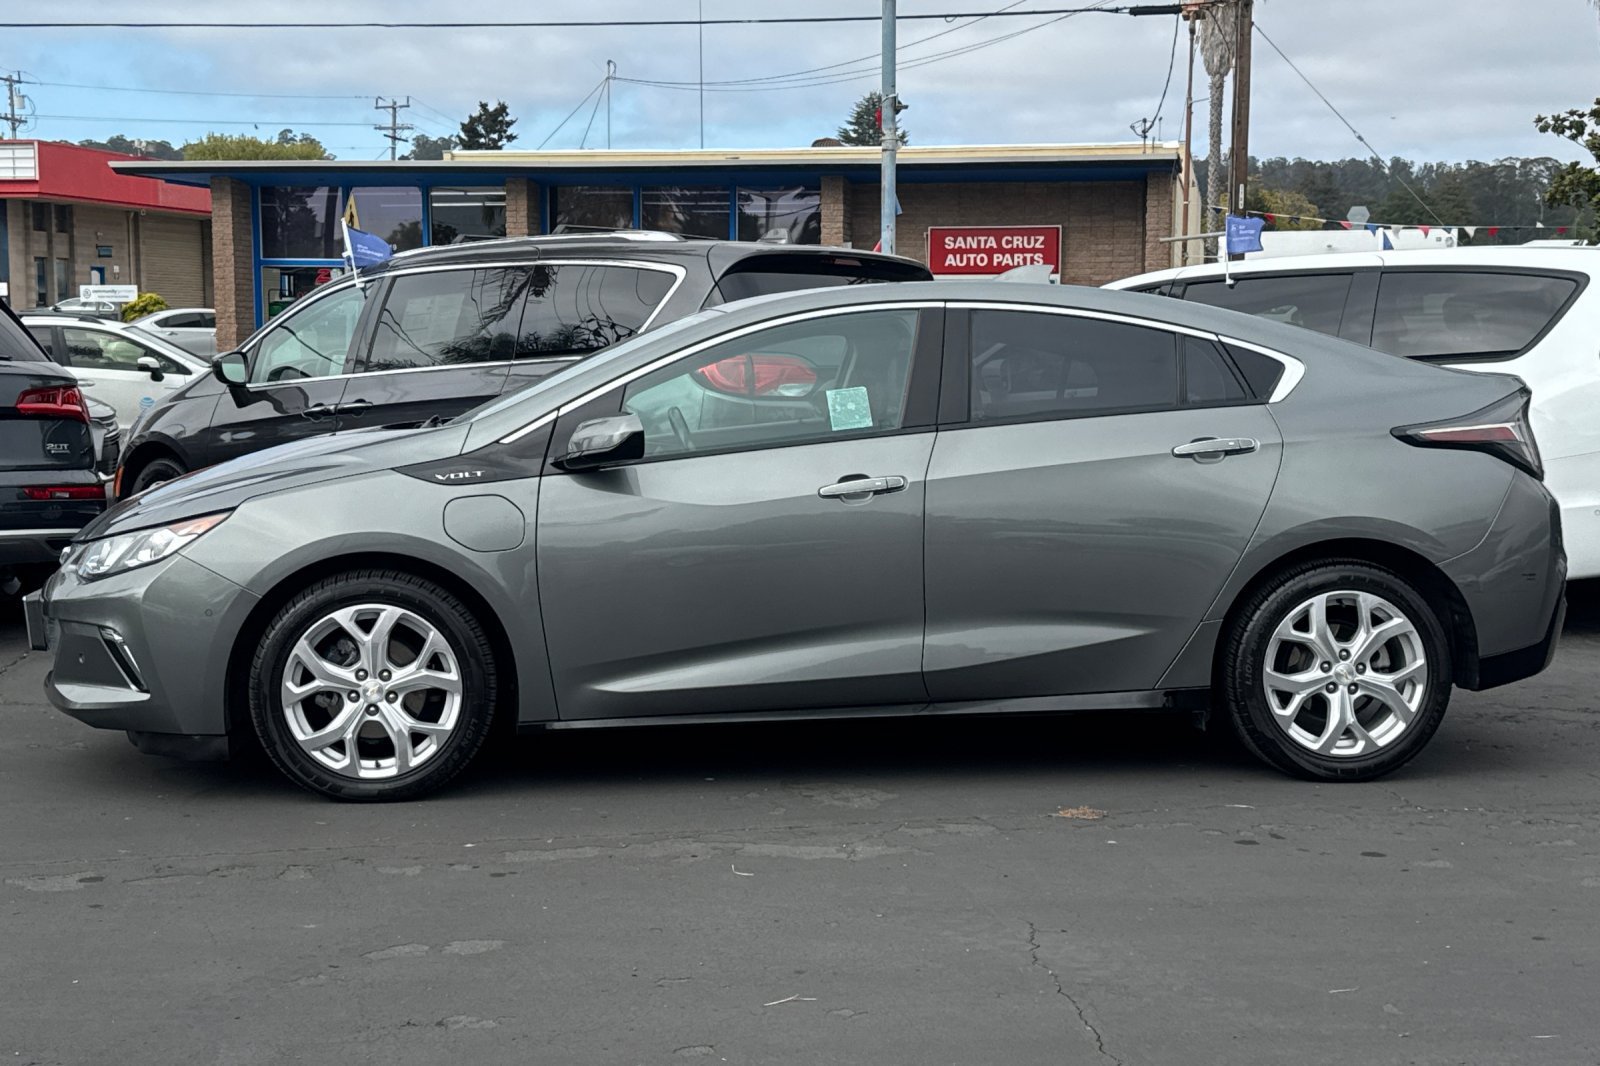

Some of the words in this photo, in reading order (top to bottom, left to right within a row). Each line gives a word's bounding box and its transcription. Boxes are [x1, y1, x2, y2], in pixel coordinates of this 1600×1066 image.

[944, 236, 998, 250] SANTA
[1001, 236, 1045, 249] CRUZ
[944, 253, 989, 267] AUTO
[993, 252, 1045, 267] PARTS
[434, 470, 486, 481] VOLT
